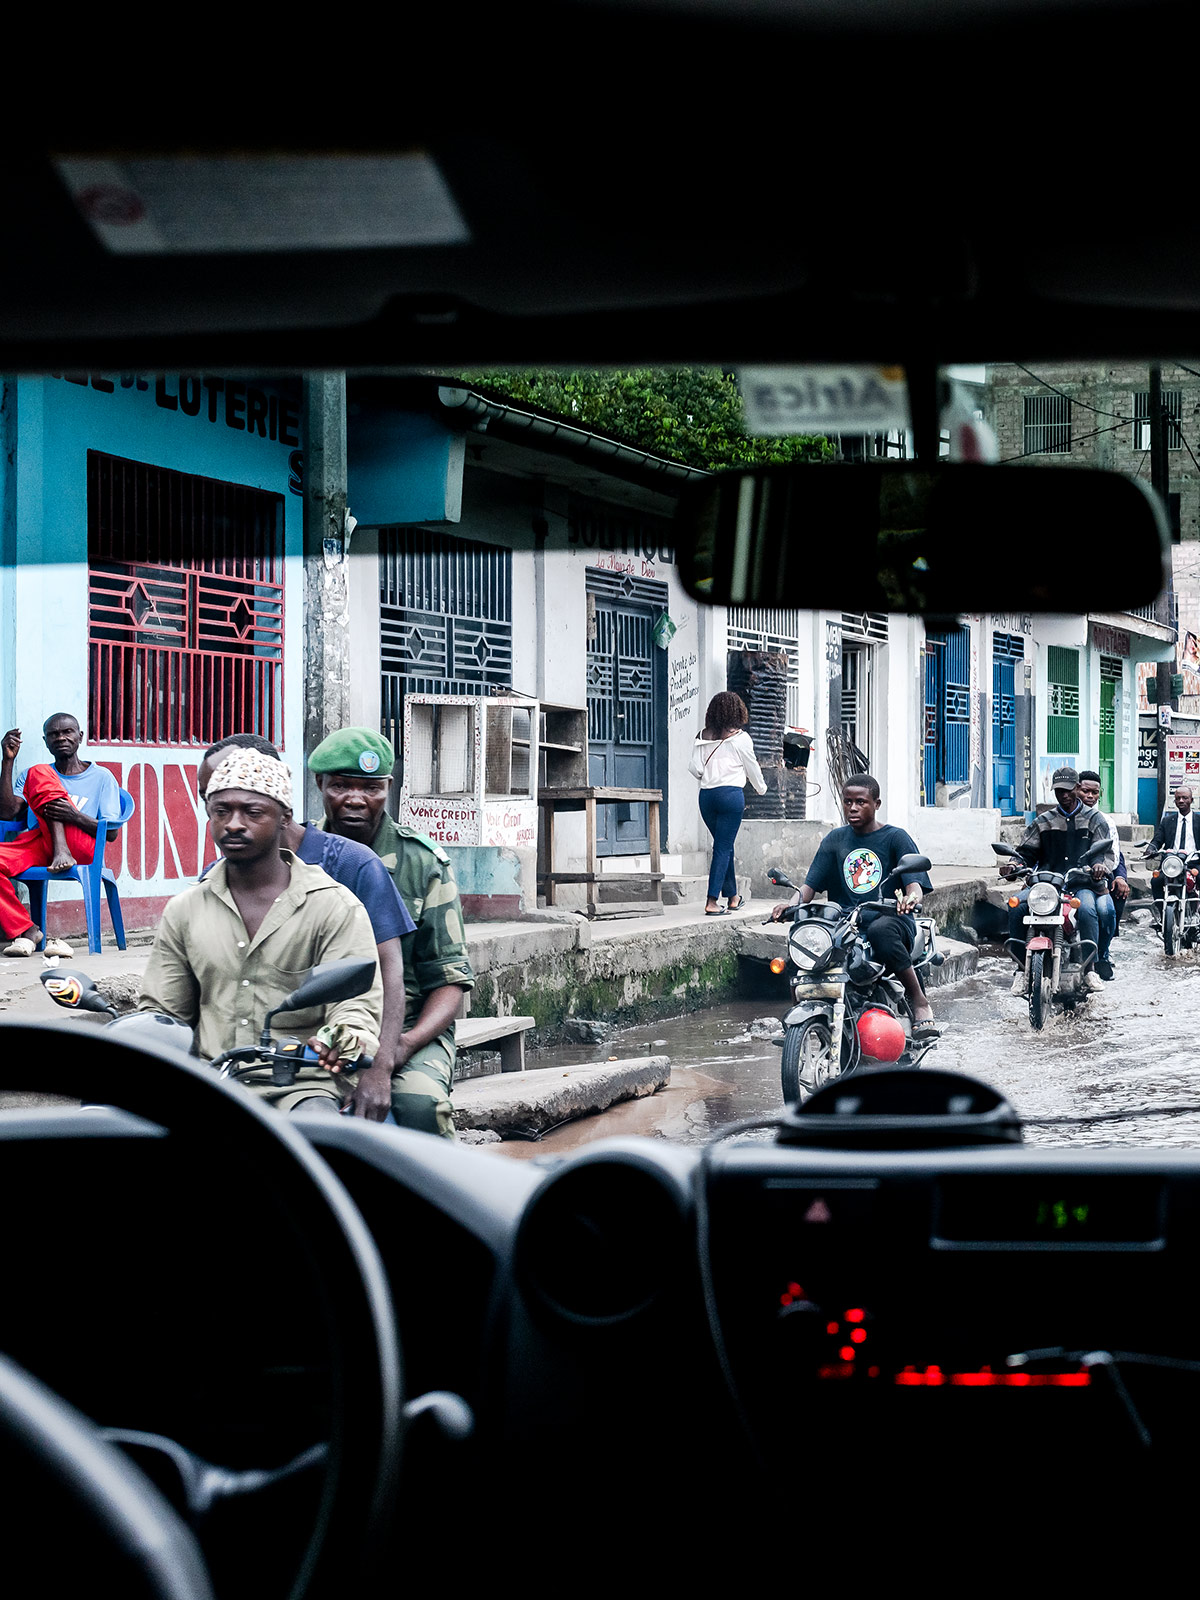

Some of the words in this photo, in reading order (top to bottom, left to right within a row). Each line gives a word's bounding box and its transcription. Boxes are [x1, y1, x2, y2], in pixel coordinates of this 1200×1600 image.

[441, 808, 477, 821] CREDIT
[436, 821, 446, 830] et
[429, 831, 460, 842] MEGA
